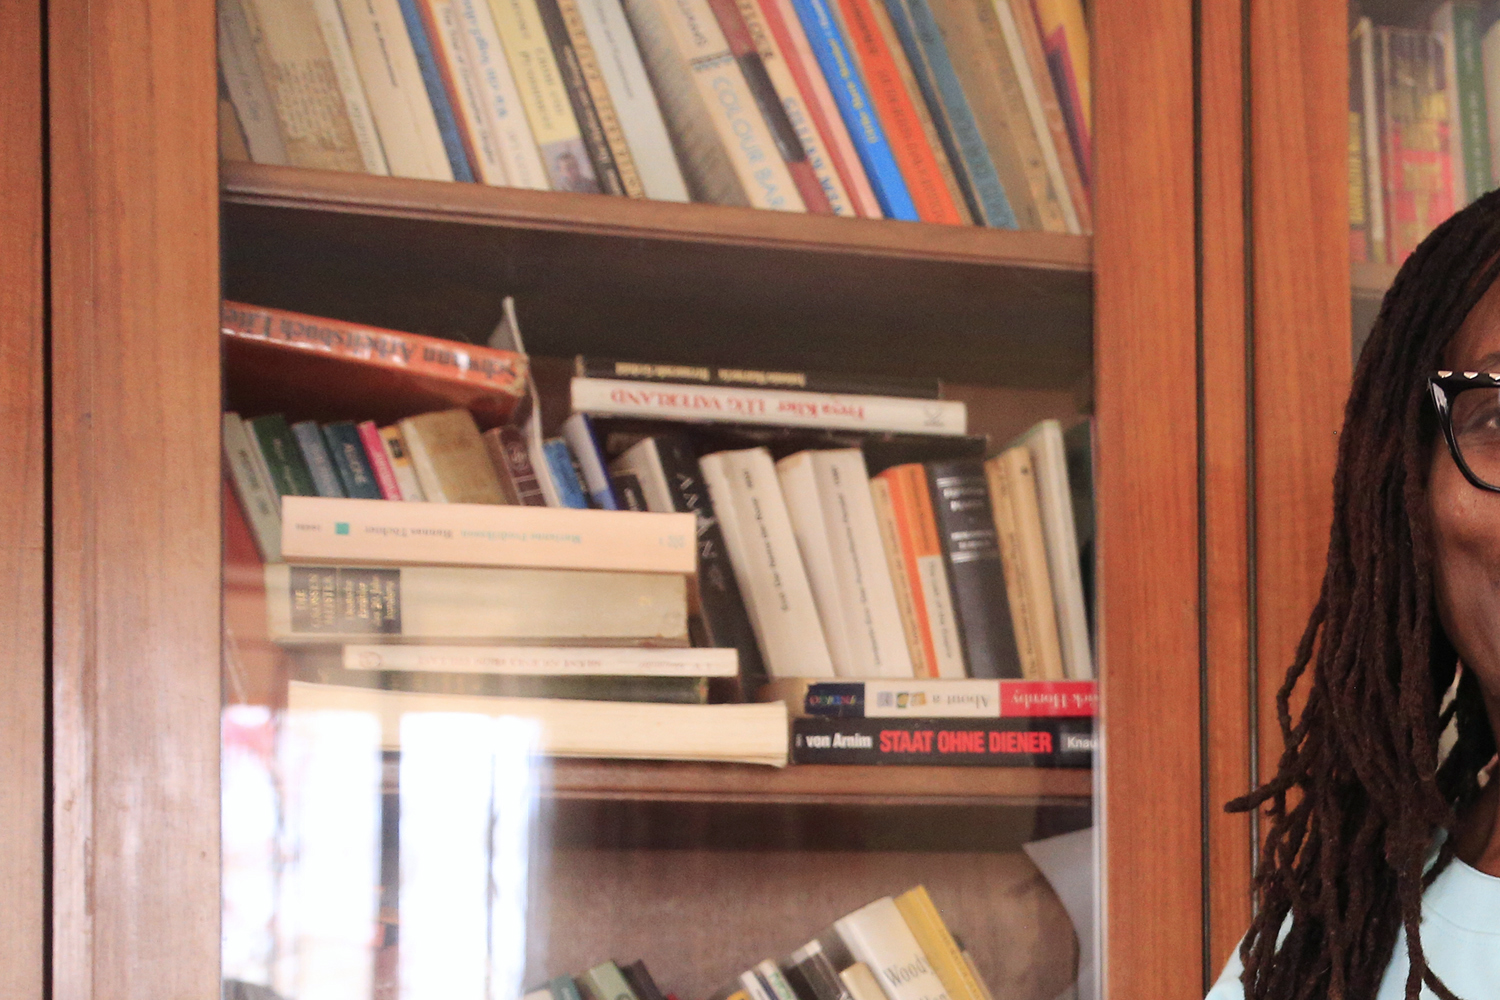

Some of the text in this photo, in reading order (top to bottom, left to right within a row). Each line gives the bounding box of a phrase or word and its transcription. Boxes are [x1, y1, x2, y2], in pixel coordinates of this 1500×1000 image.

[708, 73, 767, 167] COLOUR
[277, 315, 415, 363] Arbeitsbuch
[610, 387, 721, 411] VATERLAND
[932, 693, 940, 703] a
[946, 692, 988, 708] About
[1011, 689, 1067, 708] Hornby
[806, 735, 831, 748] von
[832, 733, 872, 748] Arnim
[879, 730, 933, 752] STAAT
[937, 731, 984, 752] OHNE
[989, 732, 1052, 753] DIENER
[884, 952, 934, 989] Woody
